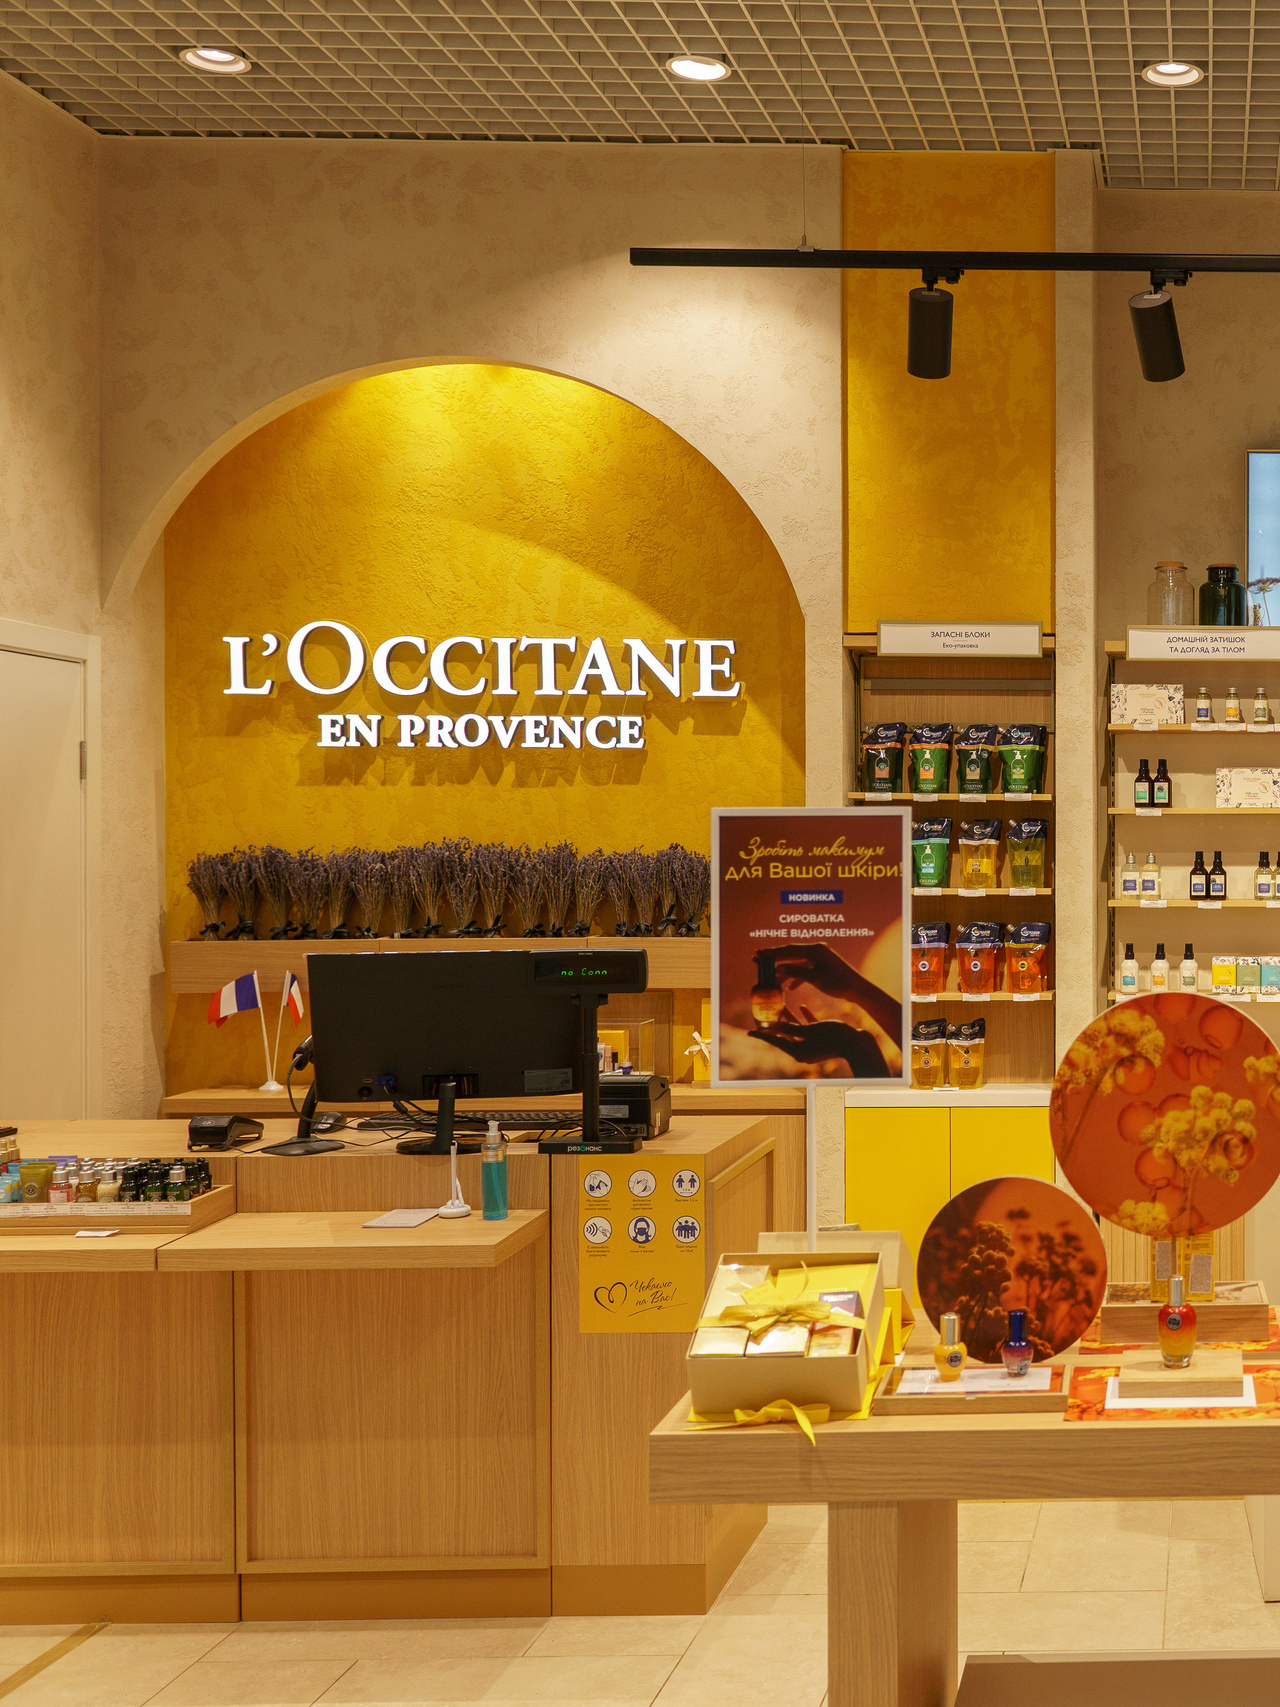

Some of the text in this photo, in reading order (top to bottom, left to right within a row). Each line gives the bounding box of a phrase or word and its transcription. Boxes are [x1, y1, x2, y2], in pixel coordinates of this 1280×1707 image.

[222, 620, 741, 698] L'OCCITANE
[317, 714, 646, 748] EN PROVENCE
[739, 836, 885, 867] Зробіть максимум
[725, 866, 762, 881] для
[770, 862, 832, 878] Вашої
[789, 893, 835, 902] НОВИНКА
[779, 914, 845, 923] СИРОВАТКА
[749, 928, 874, 938] «НІЧНЕ ВІДНОВЛЕННЯ»
[650, 1288, 677, 1304] Вас!
